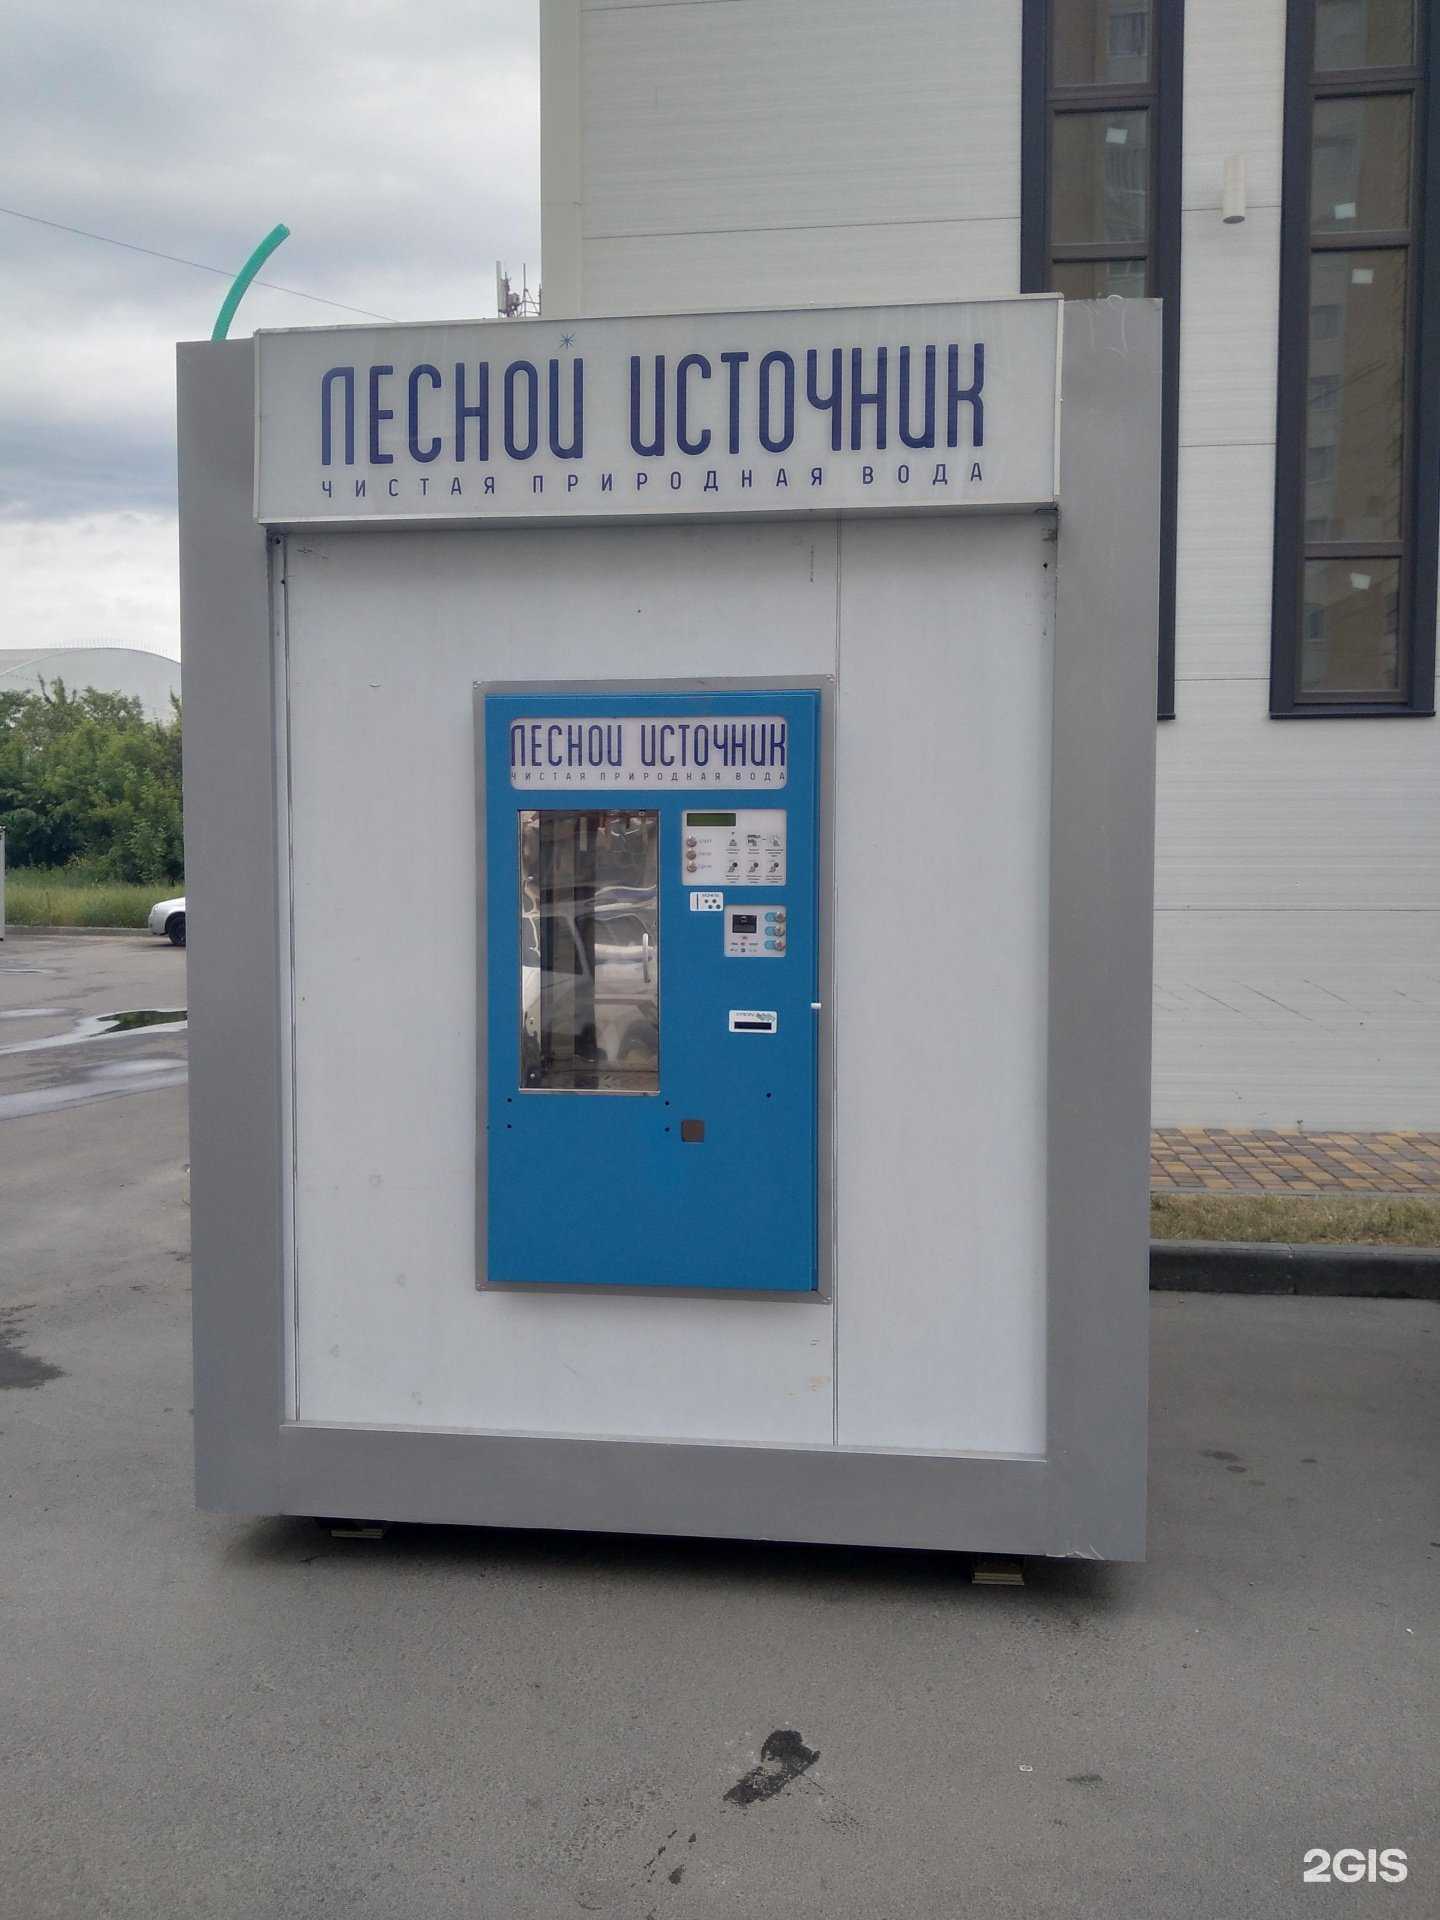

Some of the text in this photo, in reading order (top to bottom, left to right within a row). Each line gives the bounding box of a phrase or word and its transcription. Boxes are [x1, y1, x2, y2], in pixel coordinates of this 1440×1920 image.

[629, 342, 985, 457] ИСТОЧНИК
[321, 462, 983, 498] ЧИСТАЯ ПРИРОДНАЯ ВОДА
[640, 724, 786, 767] ИСТОЧНИК
[510, 771, 786, 781] ЧИСТАЯ ПРИРОДНАЯ ВОДА
